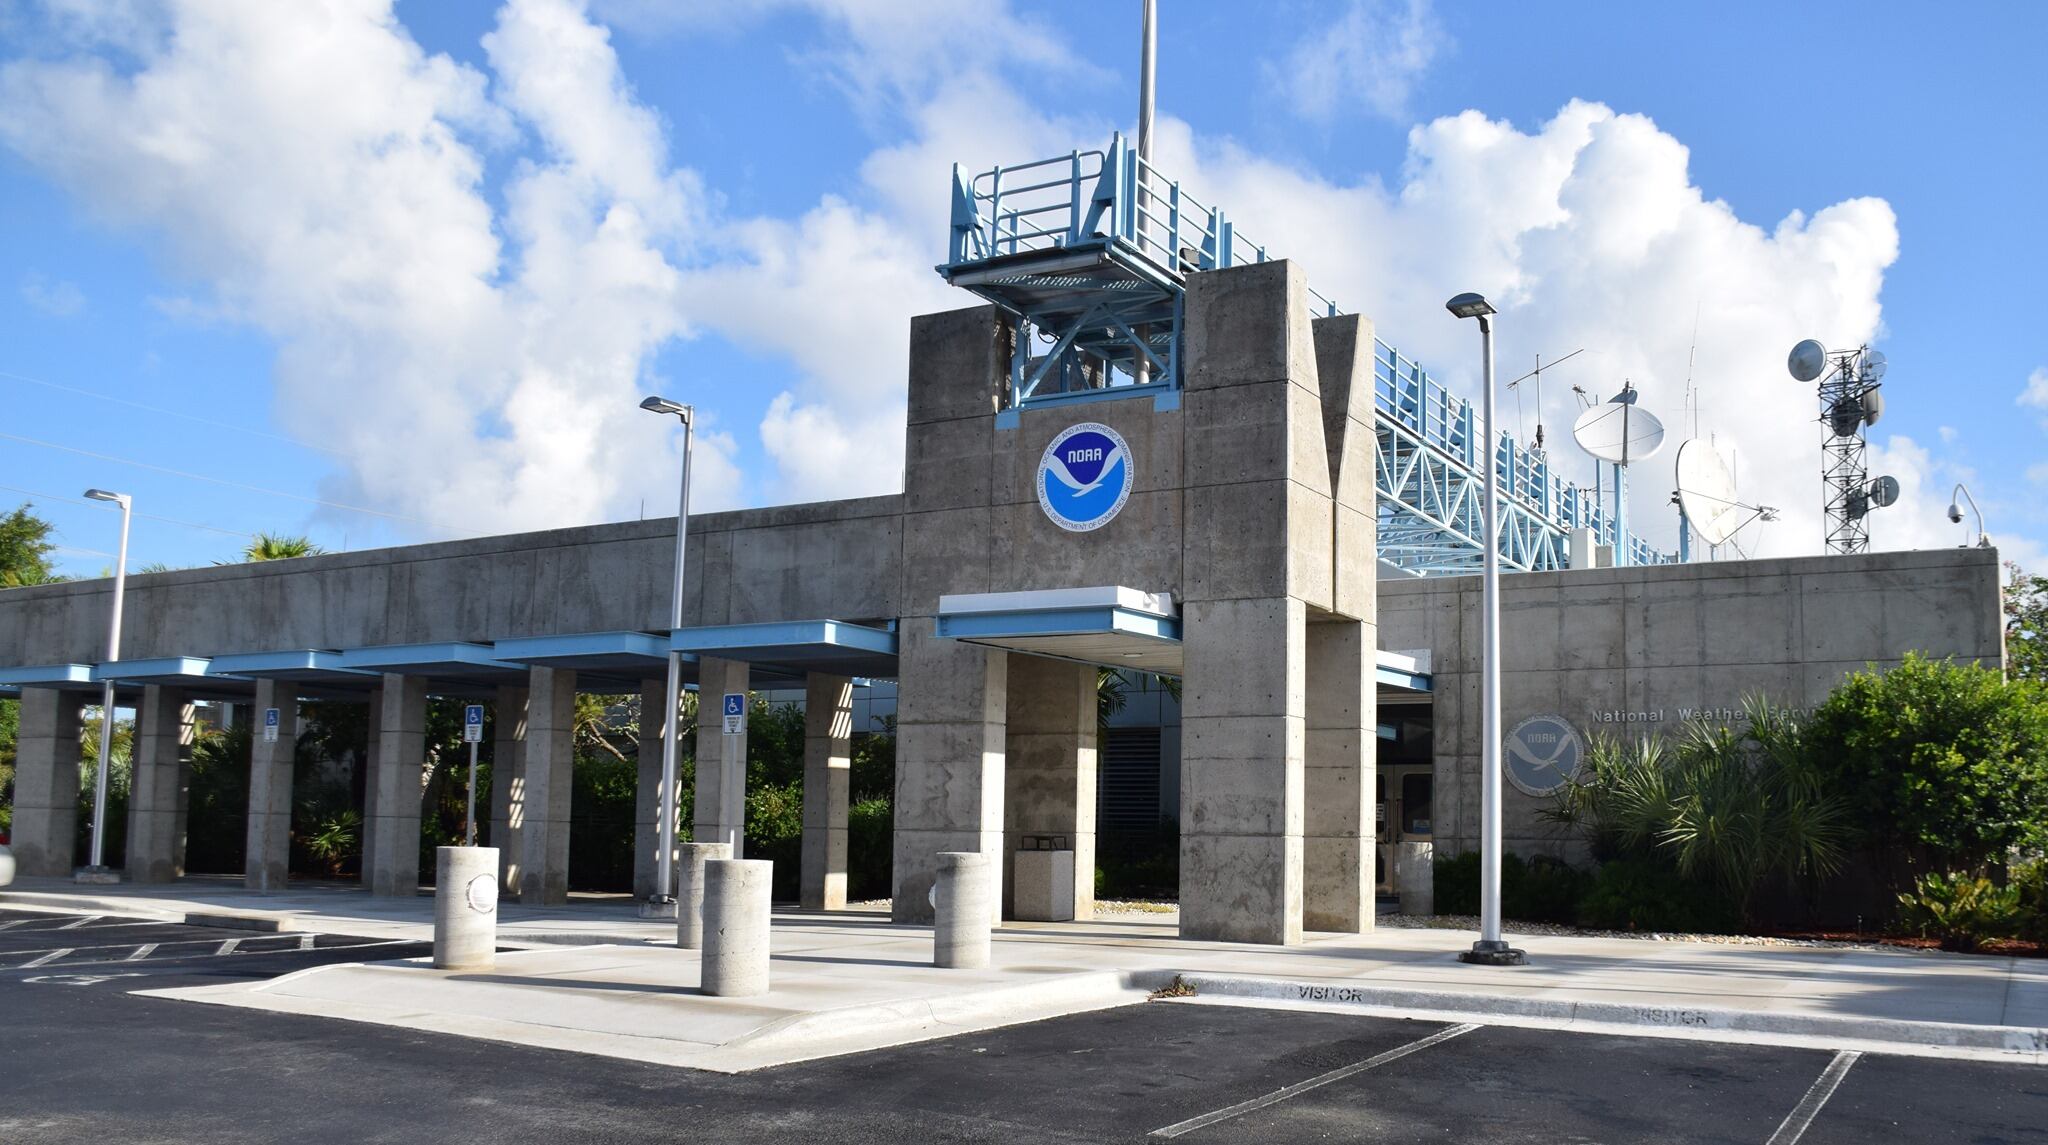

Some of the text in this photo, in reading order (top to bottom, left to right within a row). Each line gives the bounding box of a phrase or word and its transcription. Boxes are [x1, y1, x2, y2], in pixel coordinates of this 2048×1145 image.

[1043, 438, 1062, 464] OCEANIC
[1062, 429, 1076, 438] AND
[1075, 424, 1118, 440] ATMOSPHERIC
[1116, 438, 1133, 493] ADMINISTRATION
[1068, 448, 1102, 463] NOAA
[1050, 512, 1088, 530] DEPARTMENT
[1097, 496, 1126, 526] COMMERCE
[1592, 709, 1664, 723] National
[1298, 986, 1363, 1002] VISITOR
